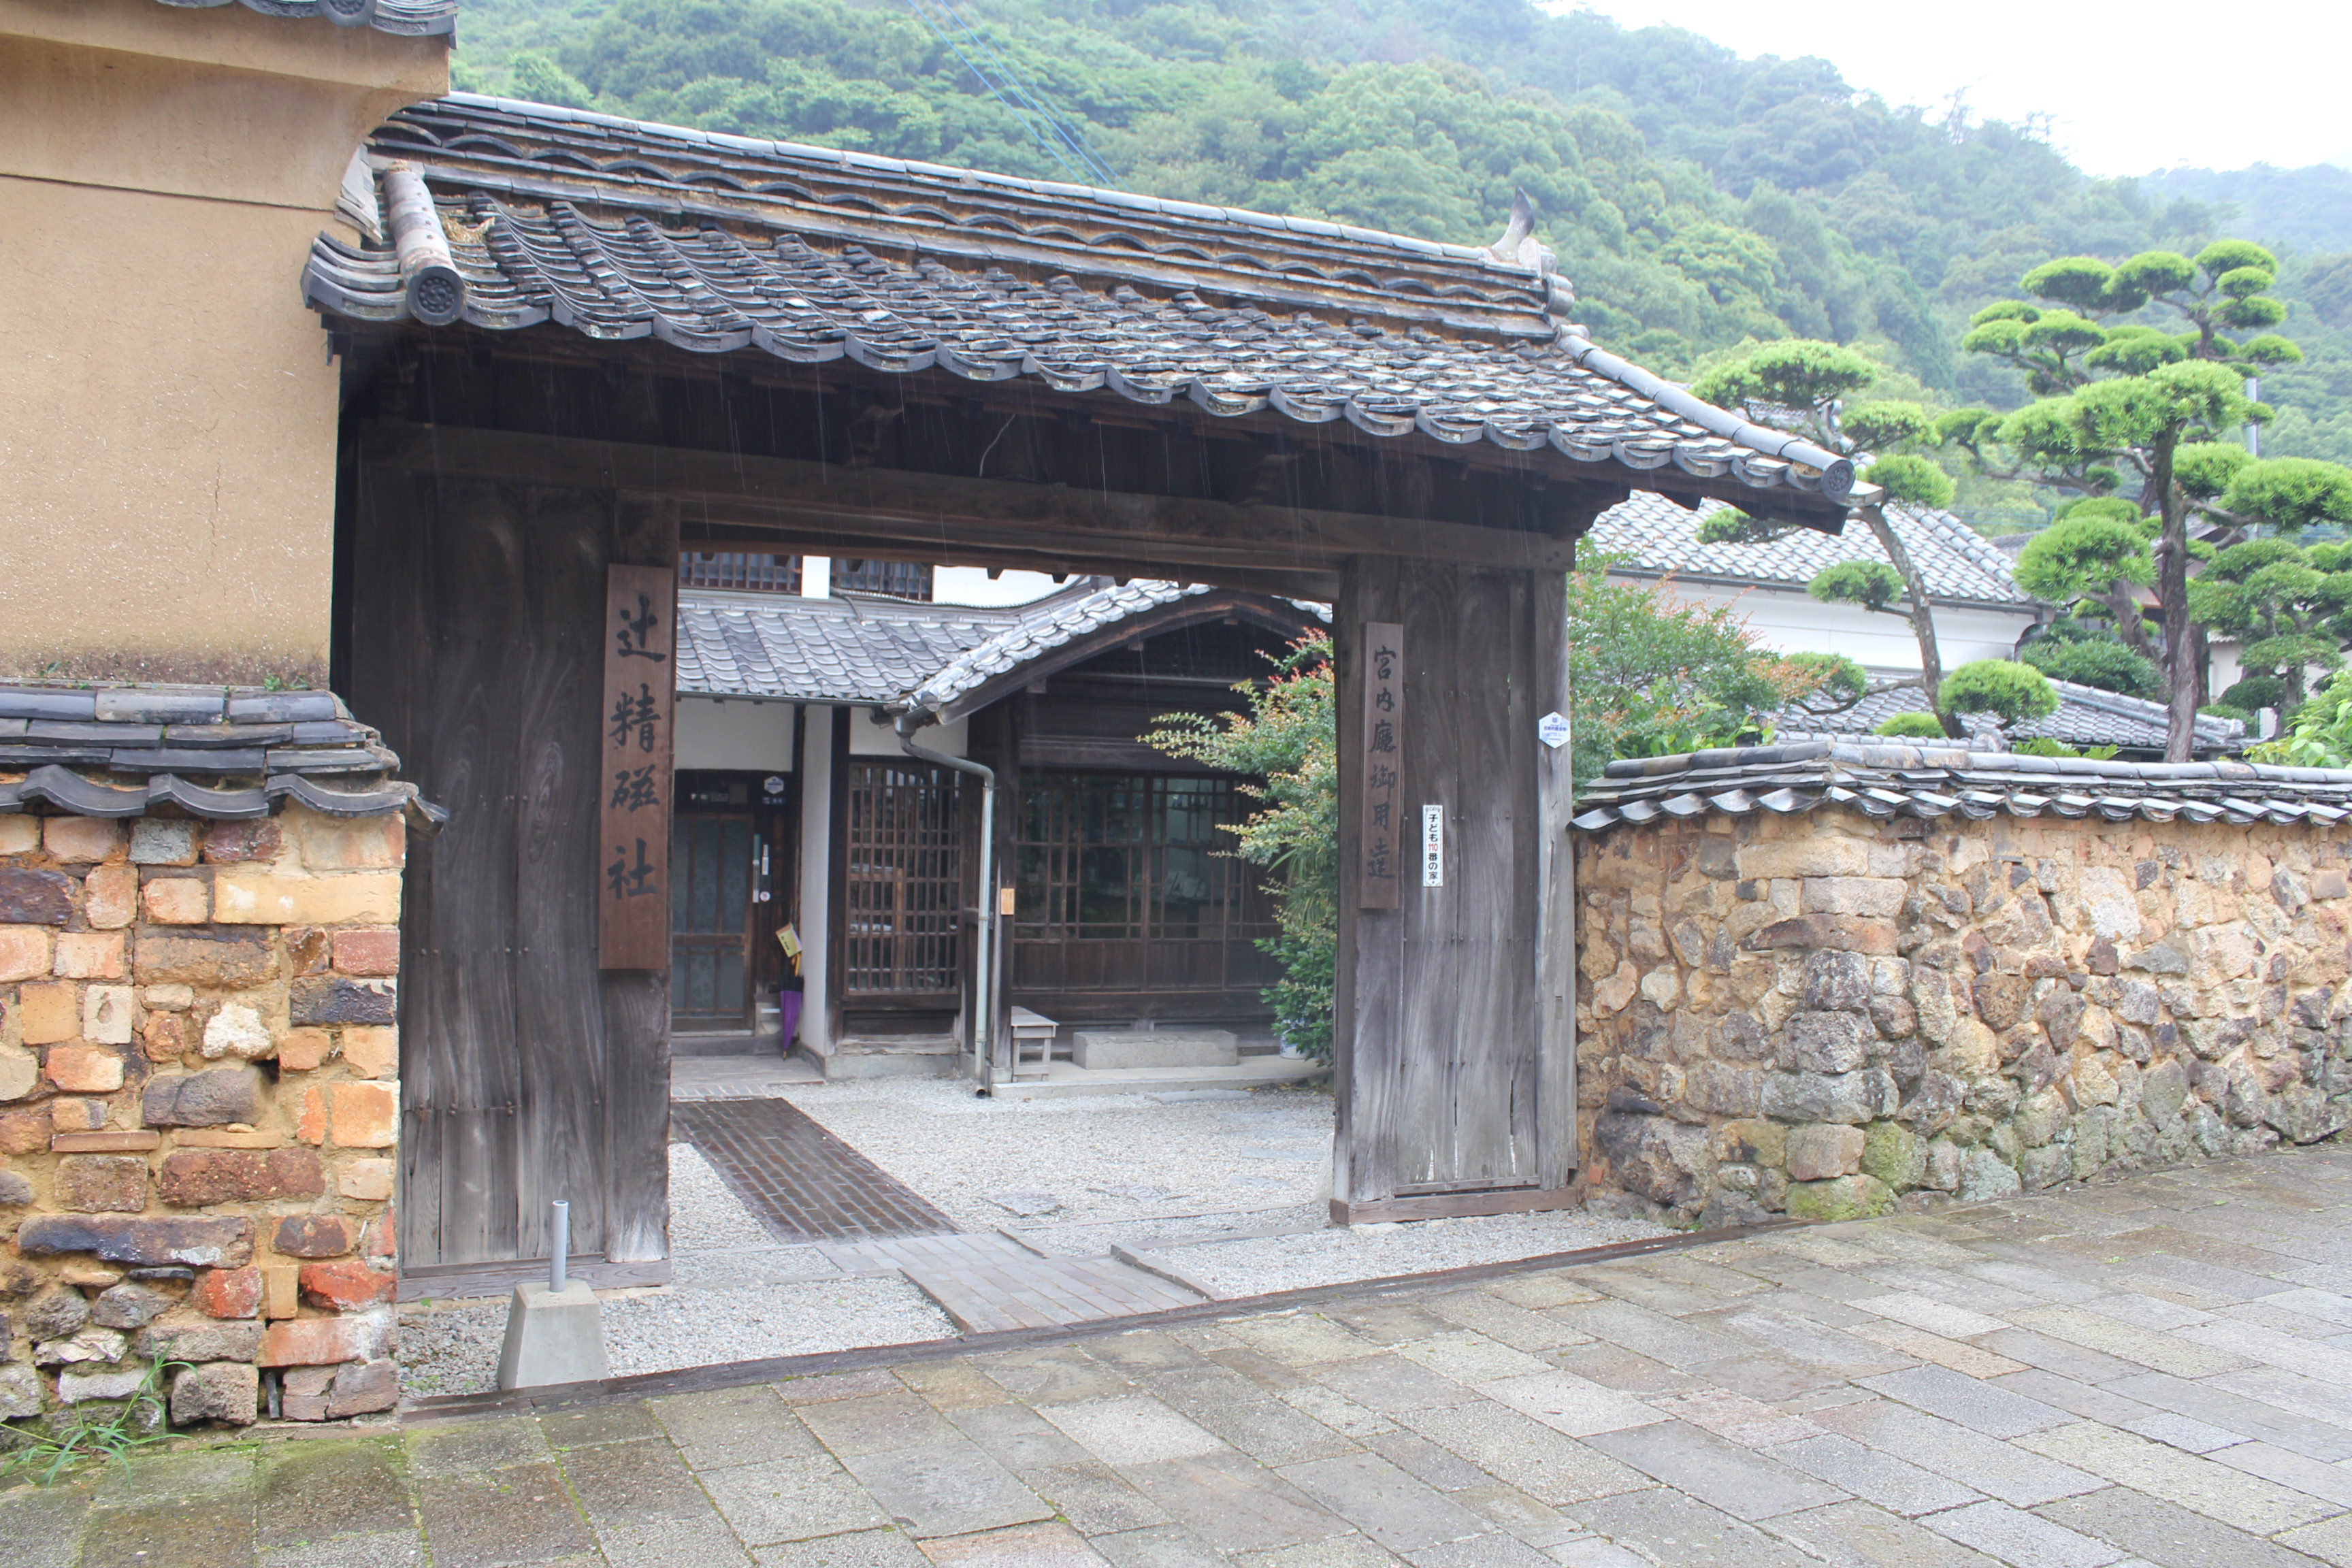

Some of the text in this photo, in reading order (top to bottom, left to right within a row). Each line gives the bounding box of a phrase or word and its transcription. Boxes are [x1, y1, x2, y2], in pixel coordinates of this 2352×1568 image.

[607, 595, 667, 900] 辻精磁社
[1428, 813, 1439, 881] 子ども110番の家
